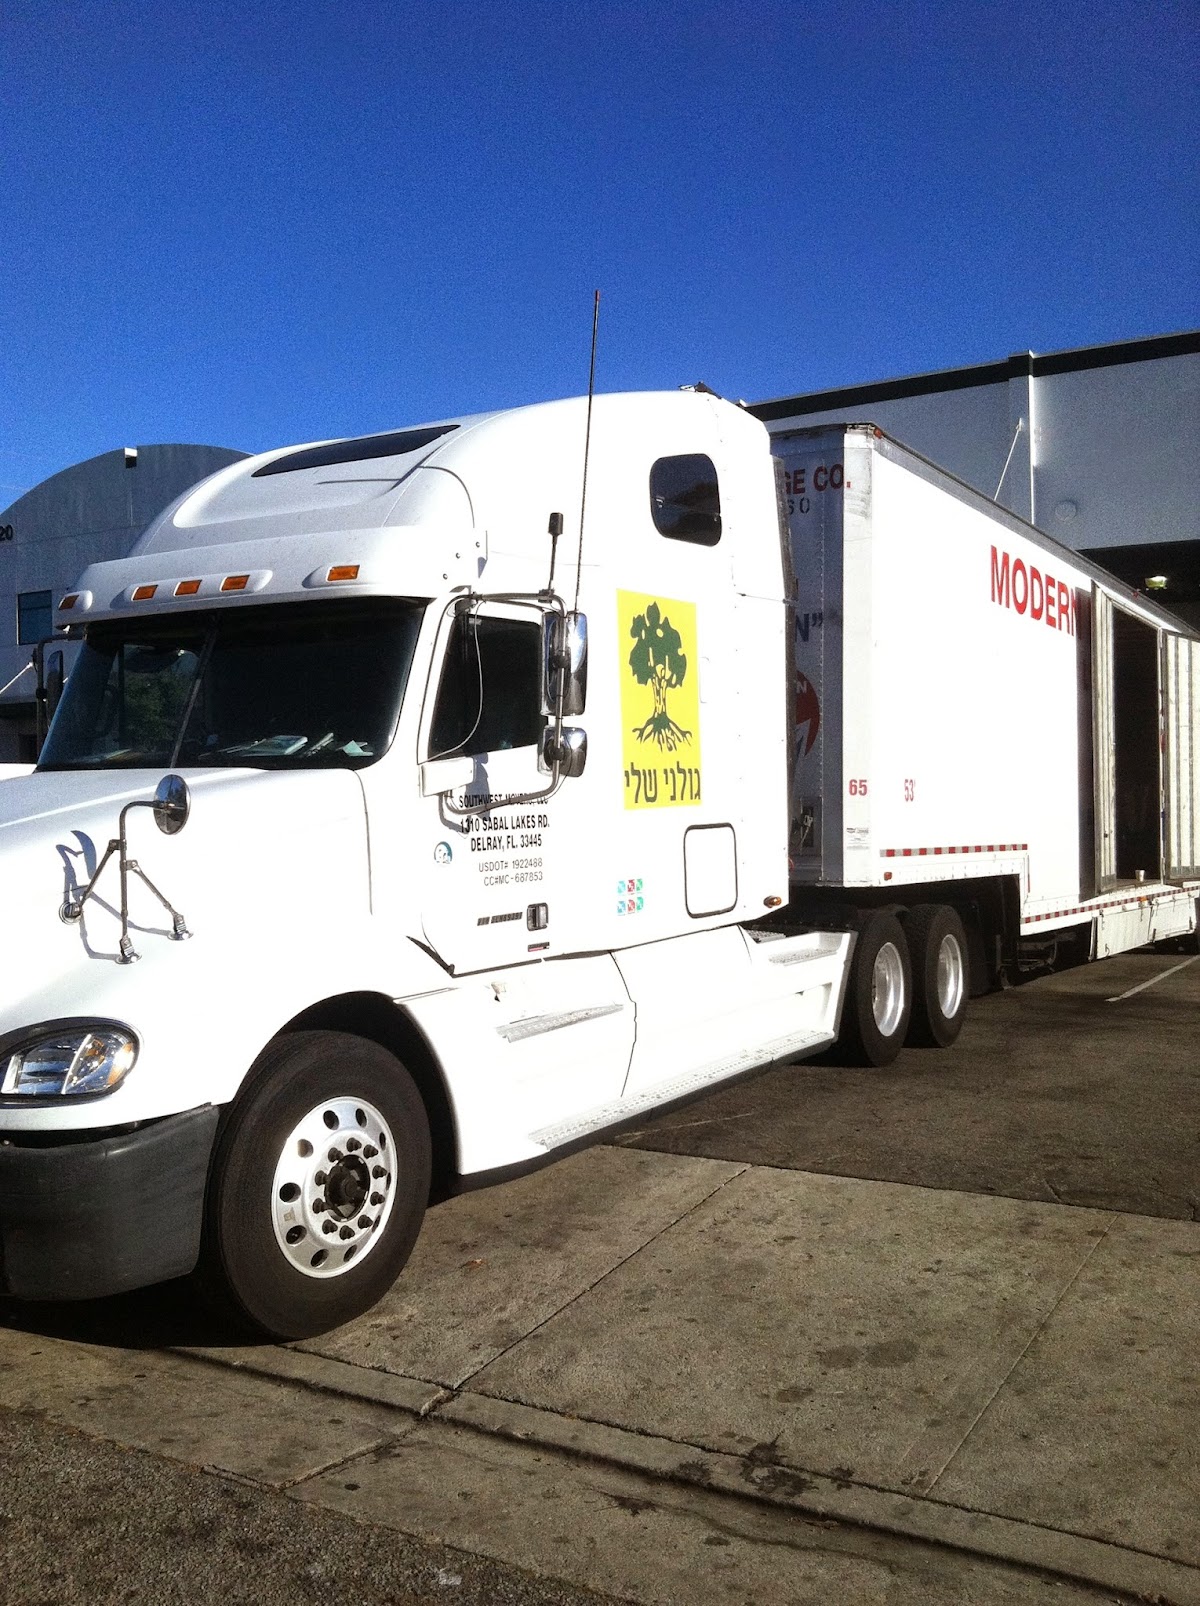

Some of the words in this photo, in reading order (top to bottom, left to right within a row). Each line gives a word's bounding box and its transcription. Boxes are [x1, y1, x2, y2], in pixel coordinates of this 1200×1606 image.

[813, 463, 851, 491] CO.
[624, 762, 658, 803] שלי
[663, 761, 701, 801] גולני
[849, 778, 868, 796] 65
[460, 817, 480, 833] 1310
[482, 816, 509, 832] SABAL
[510, 814, 536, 830] LAKES
[537, 814, 550, 829] RD.
[470, 835, 505, 852] DELRAY,
[506, 834, 518, 849] FL.
[520, 833, 542, 848] 33445
[478, 860, 509, 873] USDOT#
[511, 857, 543, 870] 1922488
